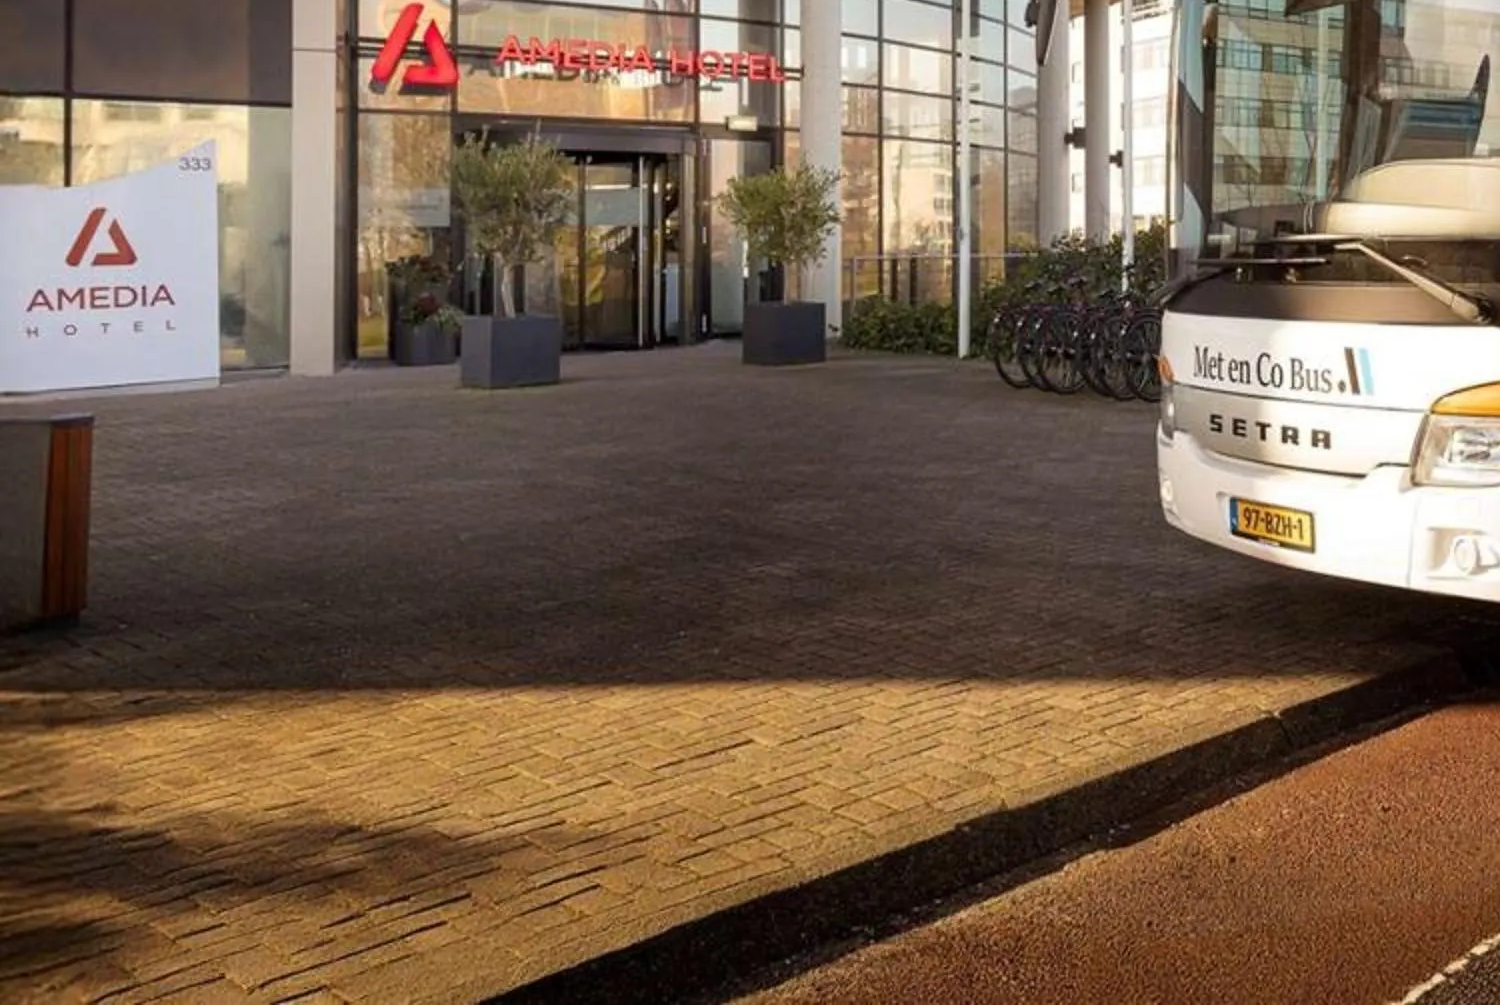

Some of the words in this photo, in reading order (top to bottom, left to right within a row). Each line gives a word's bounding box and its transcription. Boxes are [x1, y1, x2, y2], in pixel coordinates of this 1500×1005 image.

[498, 34, 656, 71] AMEDIA
[670, 49, 788, 82] HOTEL
[178, 157, 212, 171] 333
[26, 284, 176, 312] AMEDIA
[26, 320, 176, 337] HOTEL
[1194, 345, 1224, 382] Met
[1227, 357, 1251, 385] en
[1256, 352, 1284, 389] Co
[1209, 413, 1332, 449] SETRA
[1243, 506, 1304, 540] 97-BZH-1
